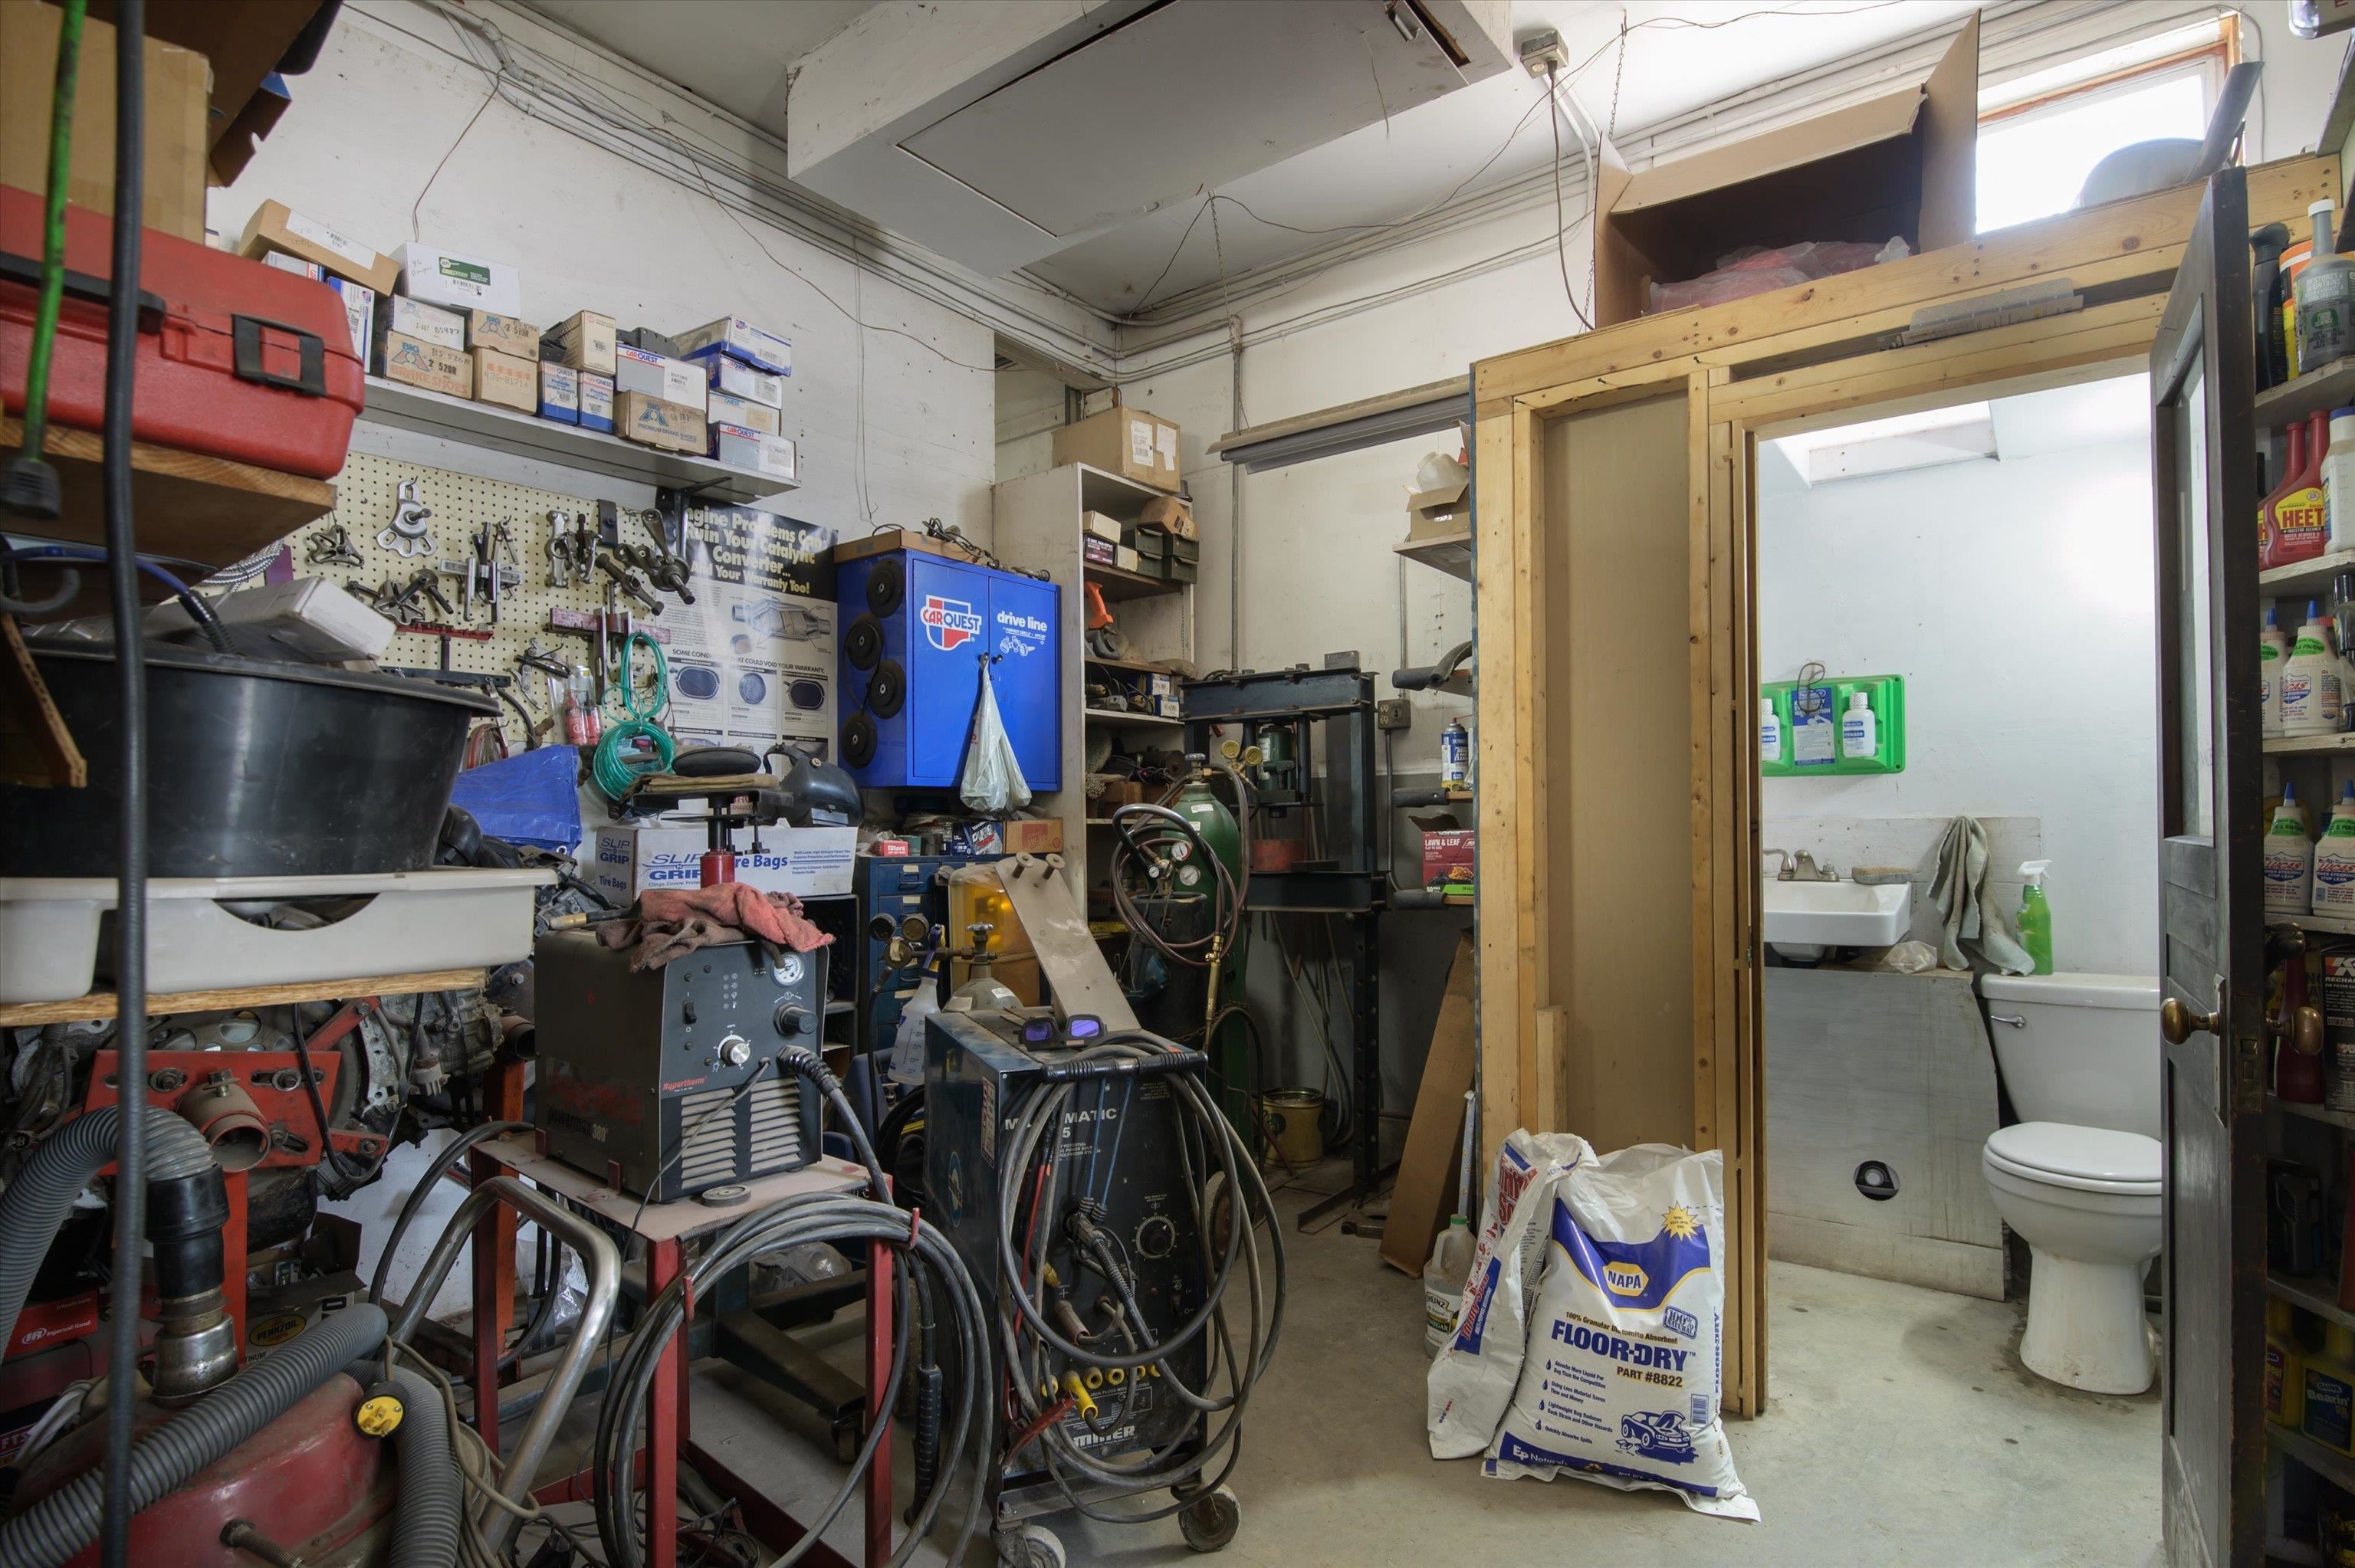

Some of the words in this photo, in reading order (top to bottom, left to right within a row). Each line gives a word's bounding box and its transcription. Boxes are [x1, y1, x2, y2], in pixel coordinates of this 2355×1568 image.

[487, 315, 500, 324] BIG
[402, 342, 420, 353] BIG
[626, 350, 658, 363] CARQUEST
[429, 359, 434, 368] 2
[438, 362, 457, 376] 520R
[390, 365, 430, 382] BRAKE
[432, 375, 468, 395] SHOES
[647, 402, 661, 411] BIG
[638, 422, 662, 434] PREMIUM
[662, 428, 679, 437] BRAKE
[727, 426, 754, 438] CARQUEST
[688, 505, 728, 526] ngine
[2282, 507, 2324, 529] HEET
[760, 539, 816, 565] Catalytic
[715, 565, 741, 580] Your
[744, 569, 790, 593] Warranty
[790, 579, 810, 594] Too!
[922, 609, 979, 631] CARQUEST
[997, 611, 1026, 627] drive
[1027, 616, 1047, 632] line
[745, 658, 763, 666] COULD
[601, 837, 630, 849] SLIP
[600, 852, 629, 864] GRIP
[652, 854, 703, 864] SLIP
[754, 855, 788, 870] Bags
[2266, 861, 2302, 870] LUCAS
[2318, 864, 2355, 872] LUCAS
[599, 875, 611, 887] Tire
[612, 877, 627, 891] Bags
[663, 1077, 705, 1091] Hypertherm
[1608, 1271, 1641, 1288] NAPA
[47, 1324, 73, 1337] Ingersoll
[257, 1320, 297, 1342] PENNZOIL
[1566, 1311, 1581, 1322] 100%
[1583, 1317, 1610, 1330] Granular
[1645, 1333, 1677, 1344] Absorbent
[1552, 1319, 1687, 1372] FLOOR-DRY
[245, 1352, 266, 1363] TINUM
[1555, 1361, 1571, 1370] Absorbs
[1582, 1370, 1596, 1379] Liquid
[1617, 1366, 1644, 1380] PART
[1645, 1373, 1683, 1388] #8822
[1551, 1381, 1562, 1389] Using
[1574, 1389, 1591, 1399] Material
[1580, 1377, 1606, 1389] Competition
[1569, 1395, 1584, 1404] Money
[1549, 1401, 1573, 1414] Lightweight
[1583, 1413, 1602, 1422] Reduces
[1545, 1425, 1561, 1436] Quickly
[1562, 1431, 1579, 1441] Absorbs
[1581, 1419, 1594, 1428] Other
[1595, 1424, 1613, 1433] Hazards
